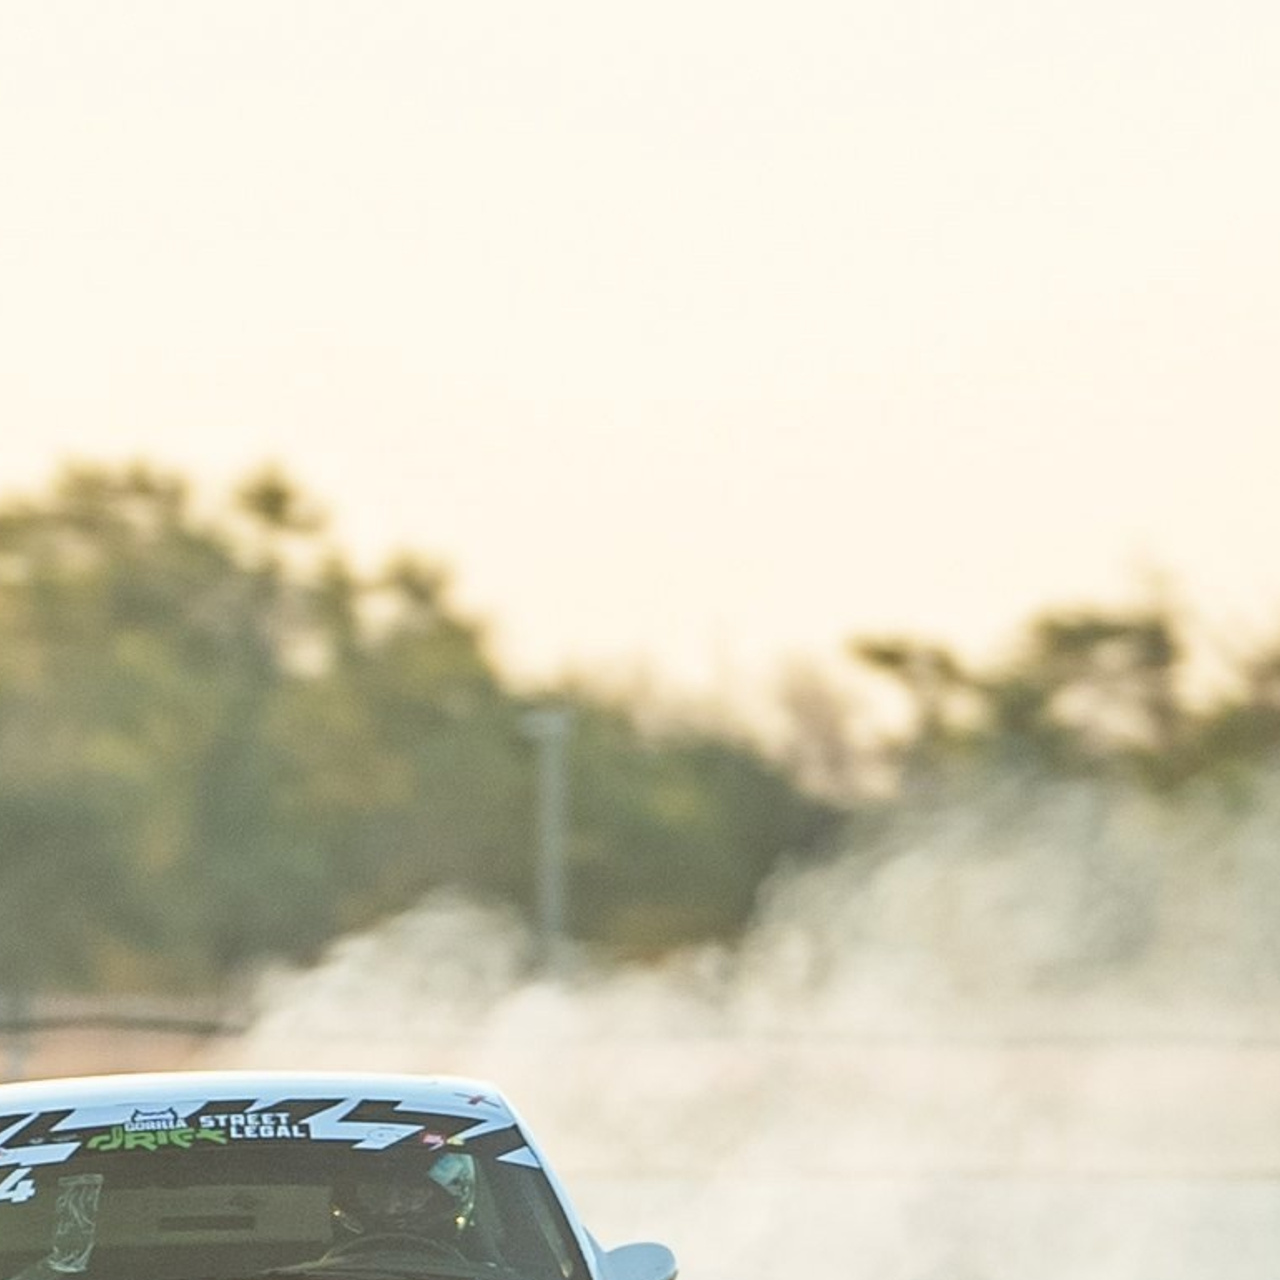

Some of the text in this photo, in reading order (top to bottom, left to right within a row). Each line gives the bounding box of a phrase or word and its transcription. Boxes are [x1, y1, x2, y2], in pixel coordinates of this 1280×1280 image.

[124, 1117, 188, 1131] GORILLA
[199, 1112, 290, 1128] STREET
[230, 1125, 307, 1138] LEGAL
